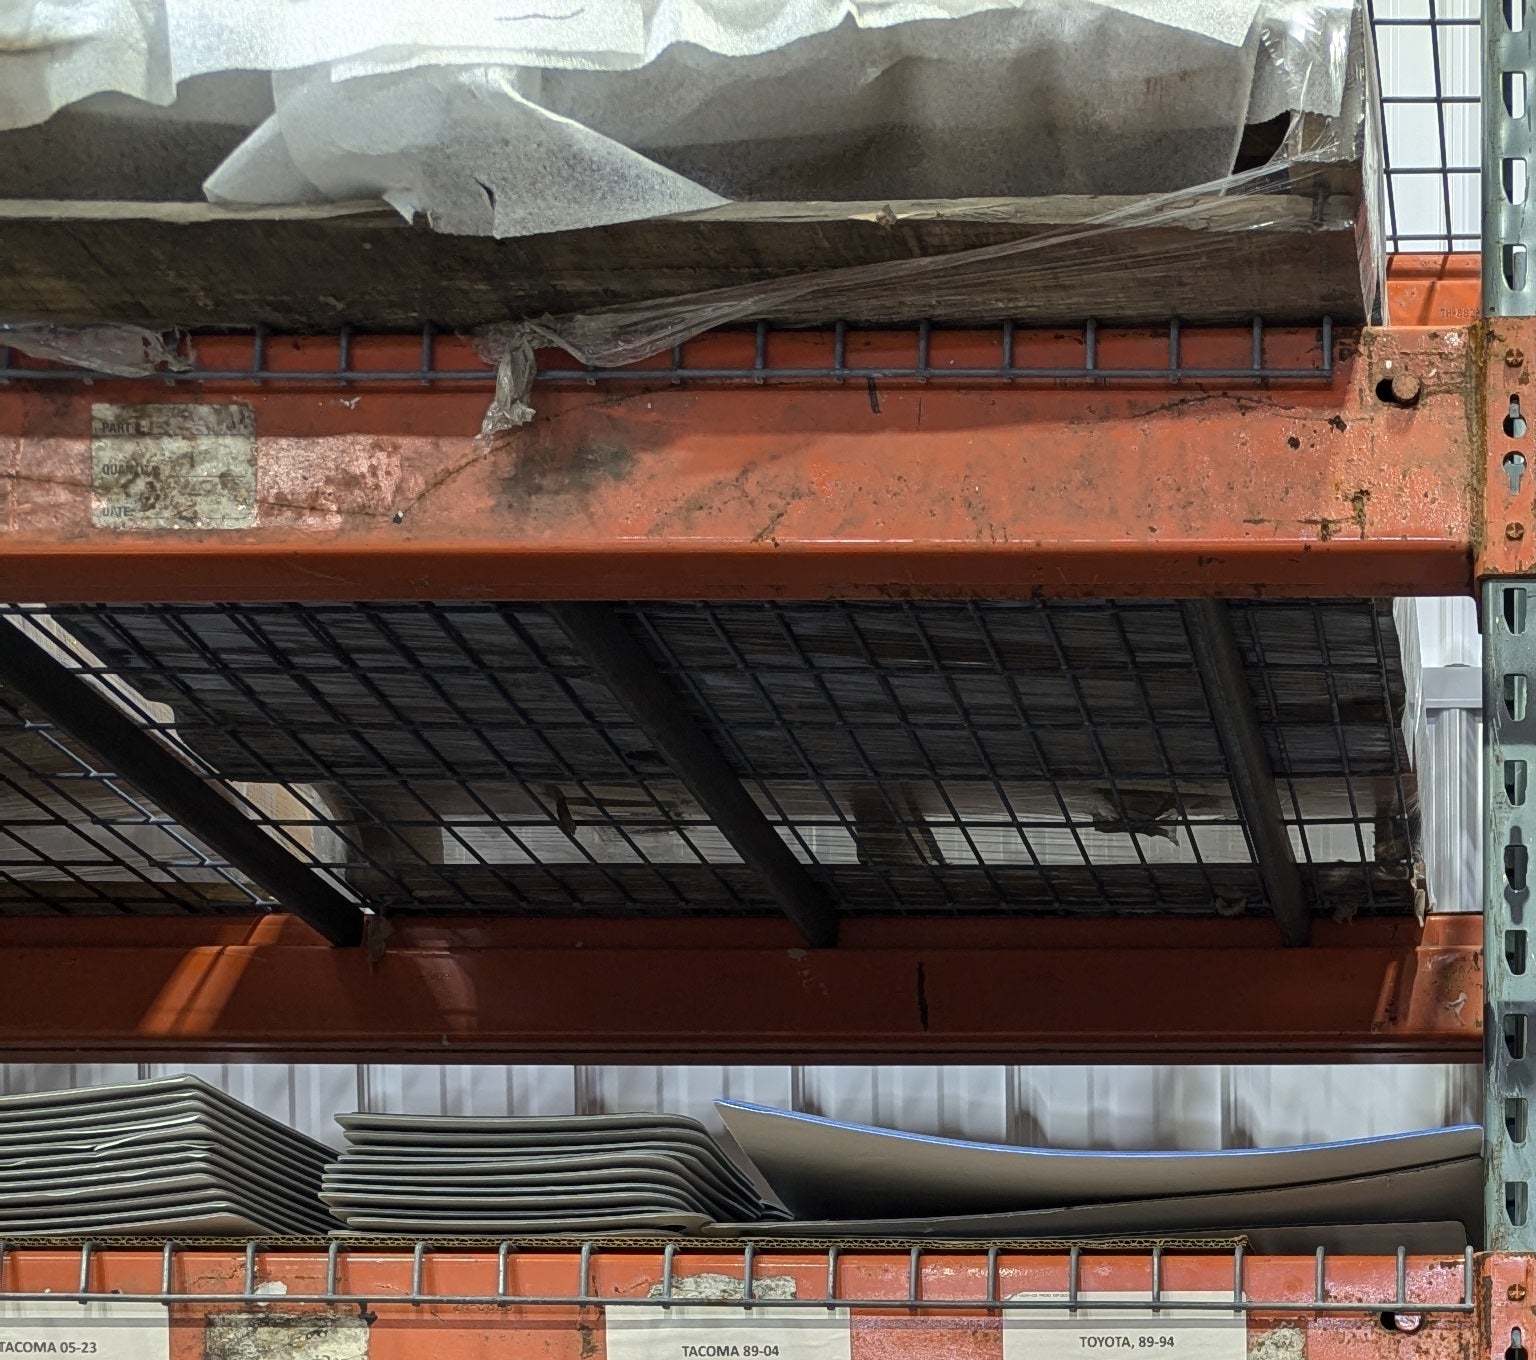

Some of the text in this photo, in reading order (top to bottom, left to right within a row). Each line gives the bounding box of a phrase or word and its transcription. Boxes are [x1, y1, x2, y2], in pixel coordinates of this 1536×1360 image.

[60, 1341, 98, 1354] 05-23
[1078, 1335, 1175, 1350] TOYOTA, 89-94
[681, 1345, 780, 1358] TACOMA 89-04
